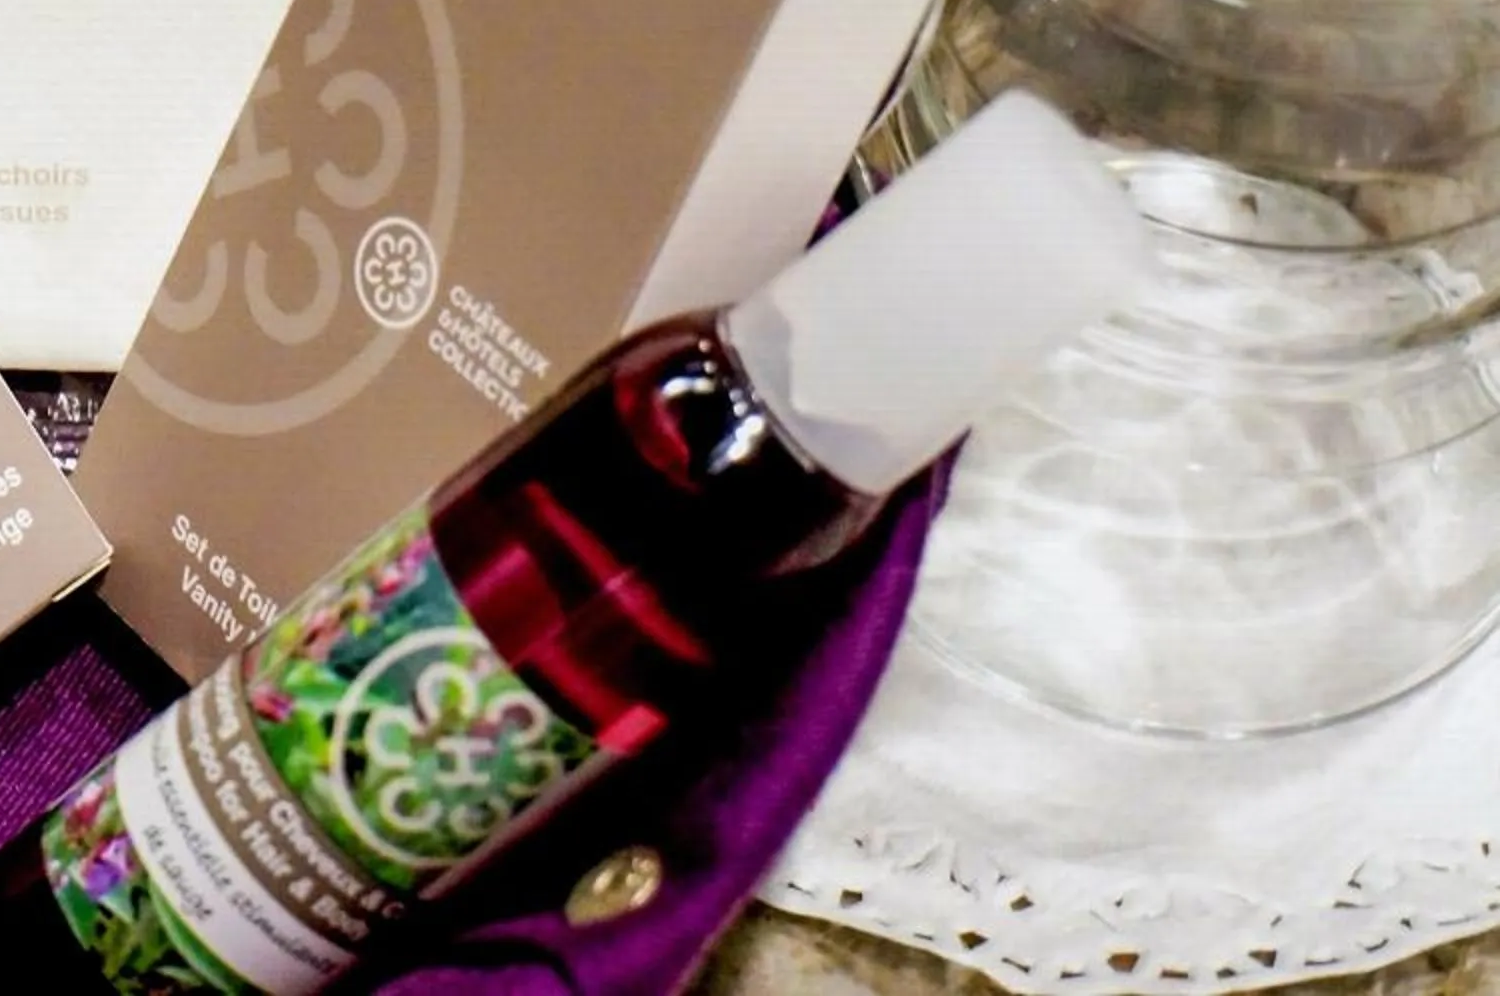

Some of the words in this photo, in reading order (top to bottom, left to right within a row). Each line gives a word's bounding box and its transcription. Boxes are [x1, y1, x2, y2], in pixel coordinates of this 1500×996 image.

[171, 513, 209, 562] Set
[209, 554, 236, 589] de
[181, 564, 244, 643] Vanity
[215, 779, 250, 823] for
[240, 820, 294, 878] Hair
[288, 877, 315, 901] &
[228, 741, 279, 802] pour
[270, 800, 366, 898] Cheveux
